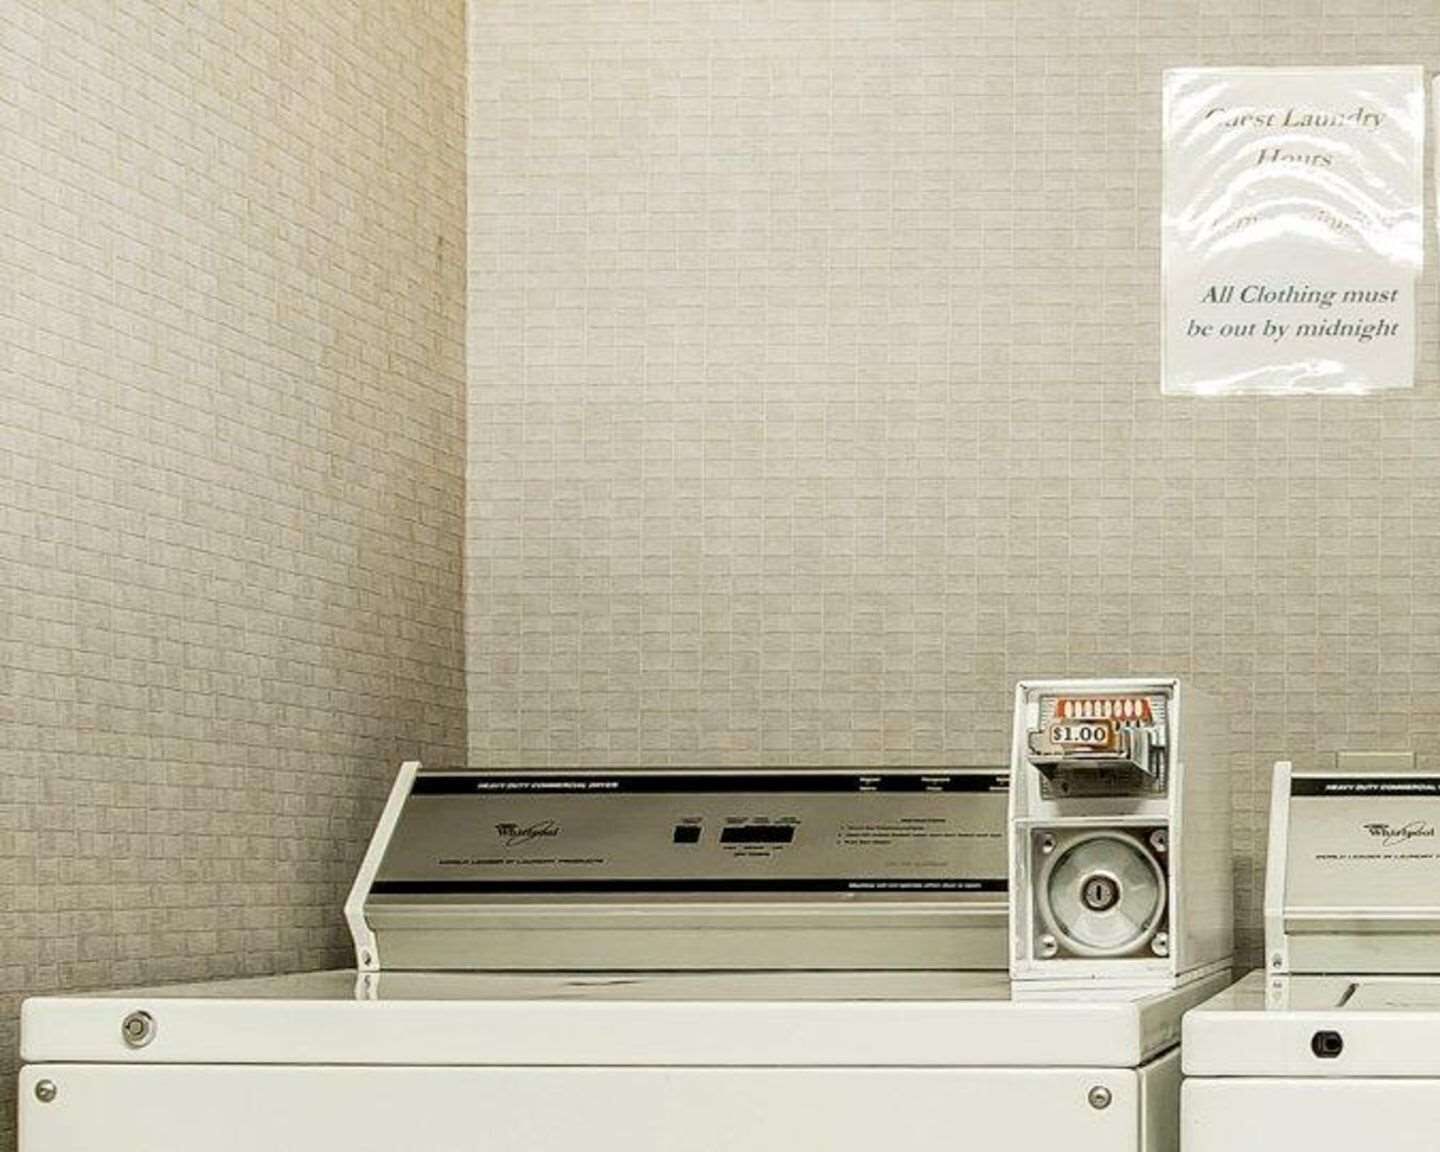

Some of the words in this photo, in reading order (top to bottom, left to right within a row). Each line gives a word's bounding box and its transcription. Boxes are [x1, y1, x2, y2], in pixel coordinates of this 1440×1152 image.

[1202, 285, 1234, 304] All
[1240, 285, 1337, 310] Clothing
[1342, 288, 1398, 304] must
[1187, 319, 1214, 337] be
[1219, 322, 1256, 338] out
[1262, 319, 1290, 343] by
[1296, 318, 1399, 342] midnight
[1053, 726, 1106, 741] $1.00
[1363, 821, 1435, 847] Whirlpool
